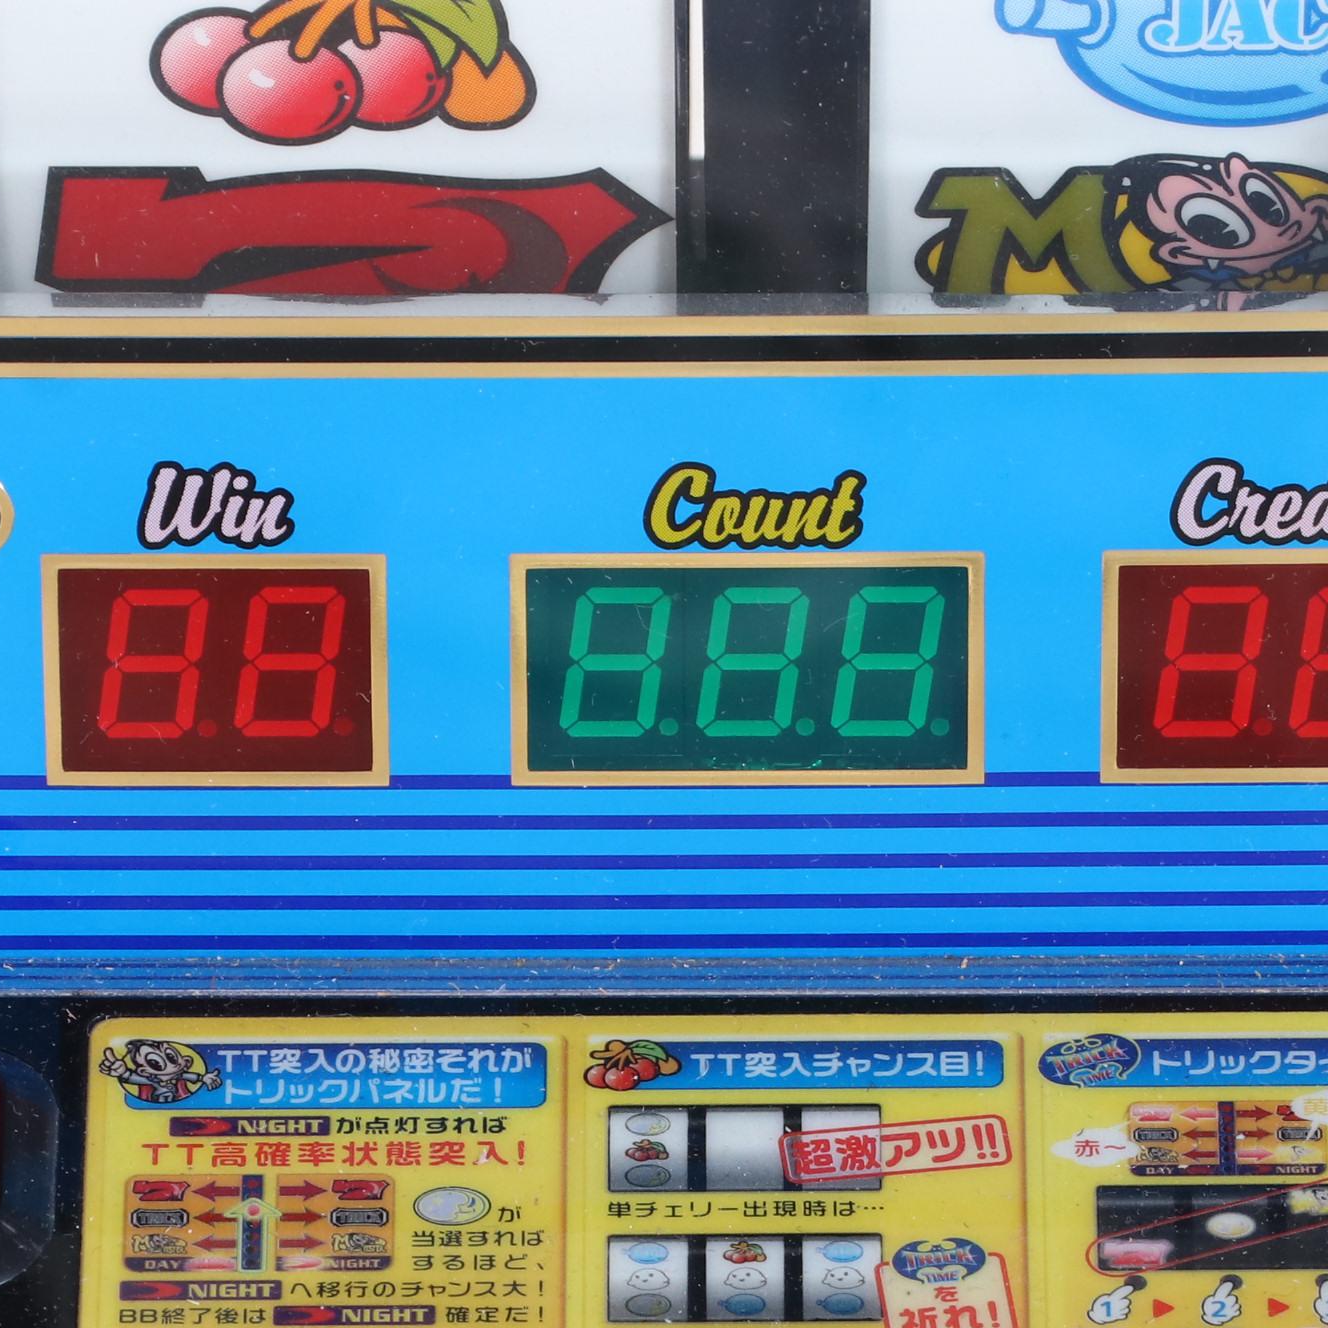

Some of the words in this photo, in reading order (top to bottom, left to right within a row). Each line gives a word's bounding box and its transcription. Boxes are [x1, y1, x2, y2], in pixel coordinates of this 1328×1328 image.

[140, 463, 293, 547] Win
[646, 462, 865, 549] Count
[217, 1047, 534, 1074] TT突入の秘密それが
[1044, 1040, 1131, 1076] TRICK
[1078, 1068, 1115, 1086] TIME
[237, 1118, 325, 1135] NIGHT
[336, 1116, 508, 1135] が点灯すれば
[1275, 1165, 1319, 1175] NIGHT
[497, 1206, 522, 1224] が
[410, 1230, 545, 1248] 当選すれば
[144, 1259, 181, 1270] DAY
[327, 1258, 382, 1270] NIGHT
[412, 1253, 547, 1271] するほど、
[899, 1245, 979, 1270] TRICK
[924, 1270, 961, 1284] TIME
[188, 1283, 276, 1299] NIGHT
[933, 1285, 960, 1302] を
[118, 1306, 267, 1326] BB終了後は
[341, 1307, 429, 1323] NIGHT
[1099, 1301, 1113, 1318] 1
[1210, 1301, 1227, 1318] 2
